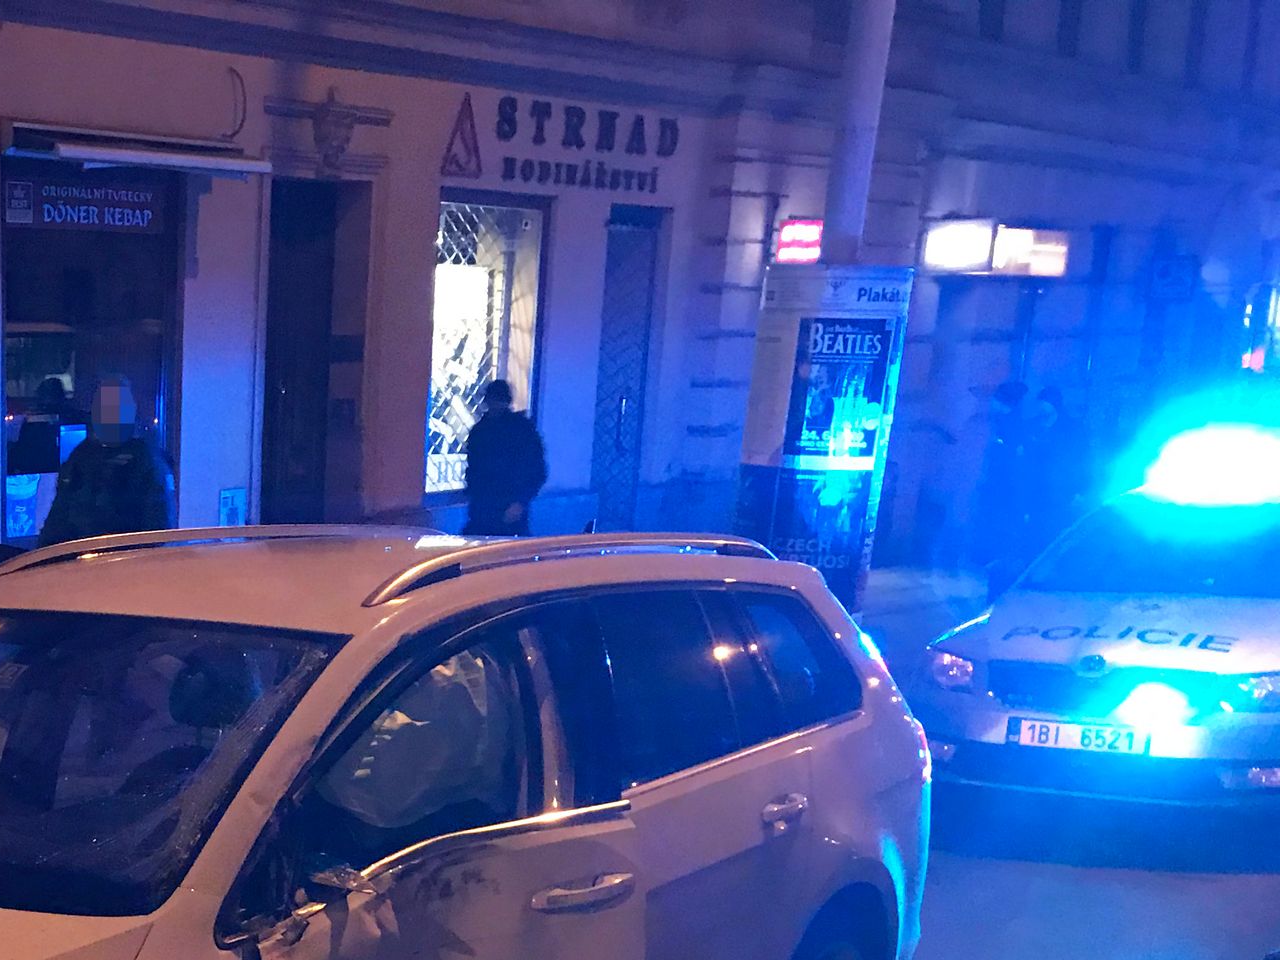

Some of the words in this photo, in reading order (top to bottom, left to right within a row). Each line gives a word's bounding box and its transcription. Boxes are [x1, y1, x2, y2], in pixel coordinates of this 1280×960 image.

[496, 96, 680, 157] STRNAD
[42, 199, 99, 225] DÖNER
[104, 206, 153, 227] KEBAP
[808, 322, 882, 355] BEATLES
[1002, 625, 1239, 653] POLICIE
[1027, 723, 1060, 745] 1BI
[1079, 728, 1134, 751] 6521
